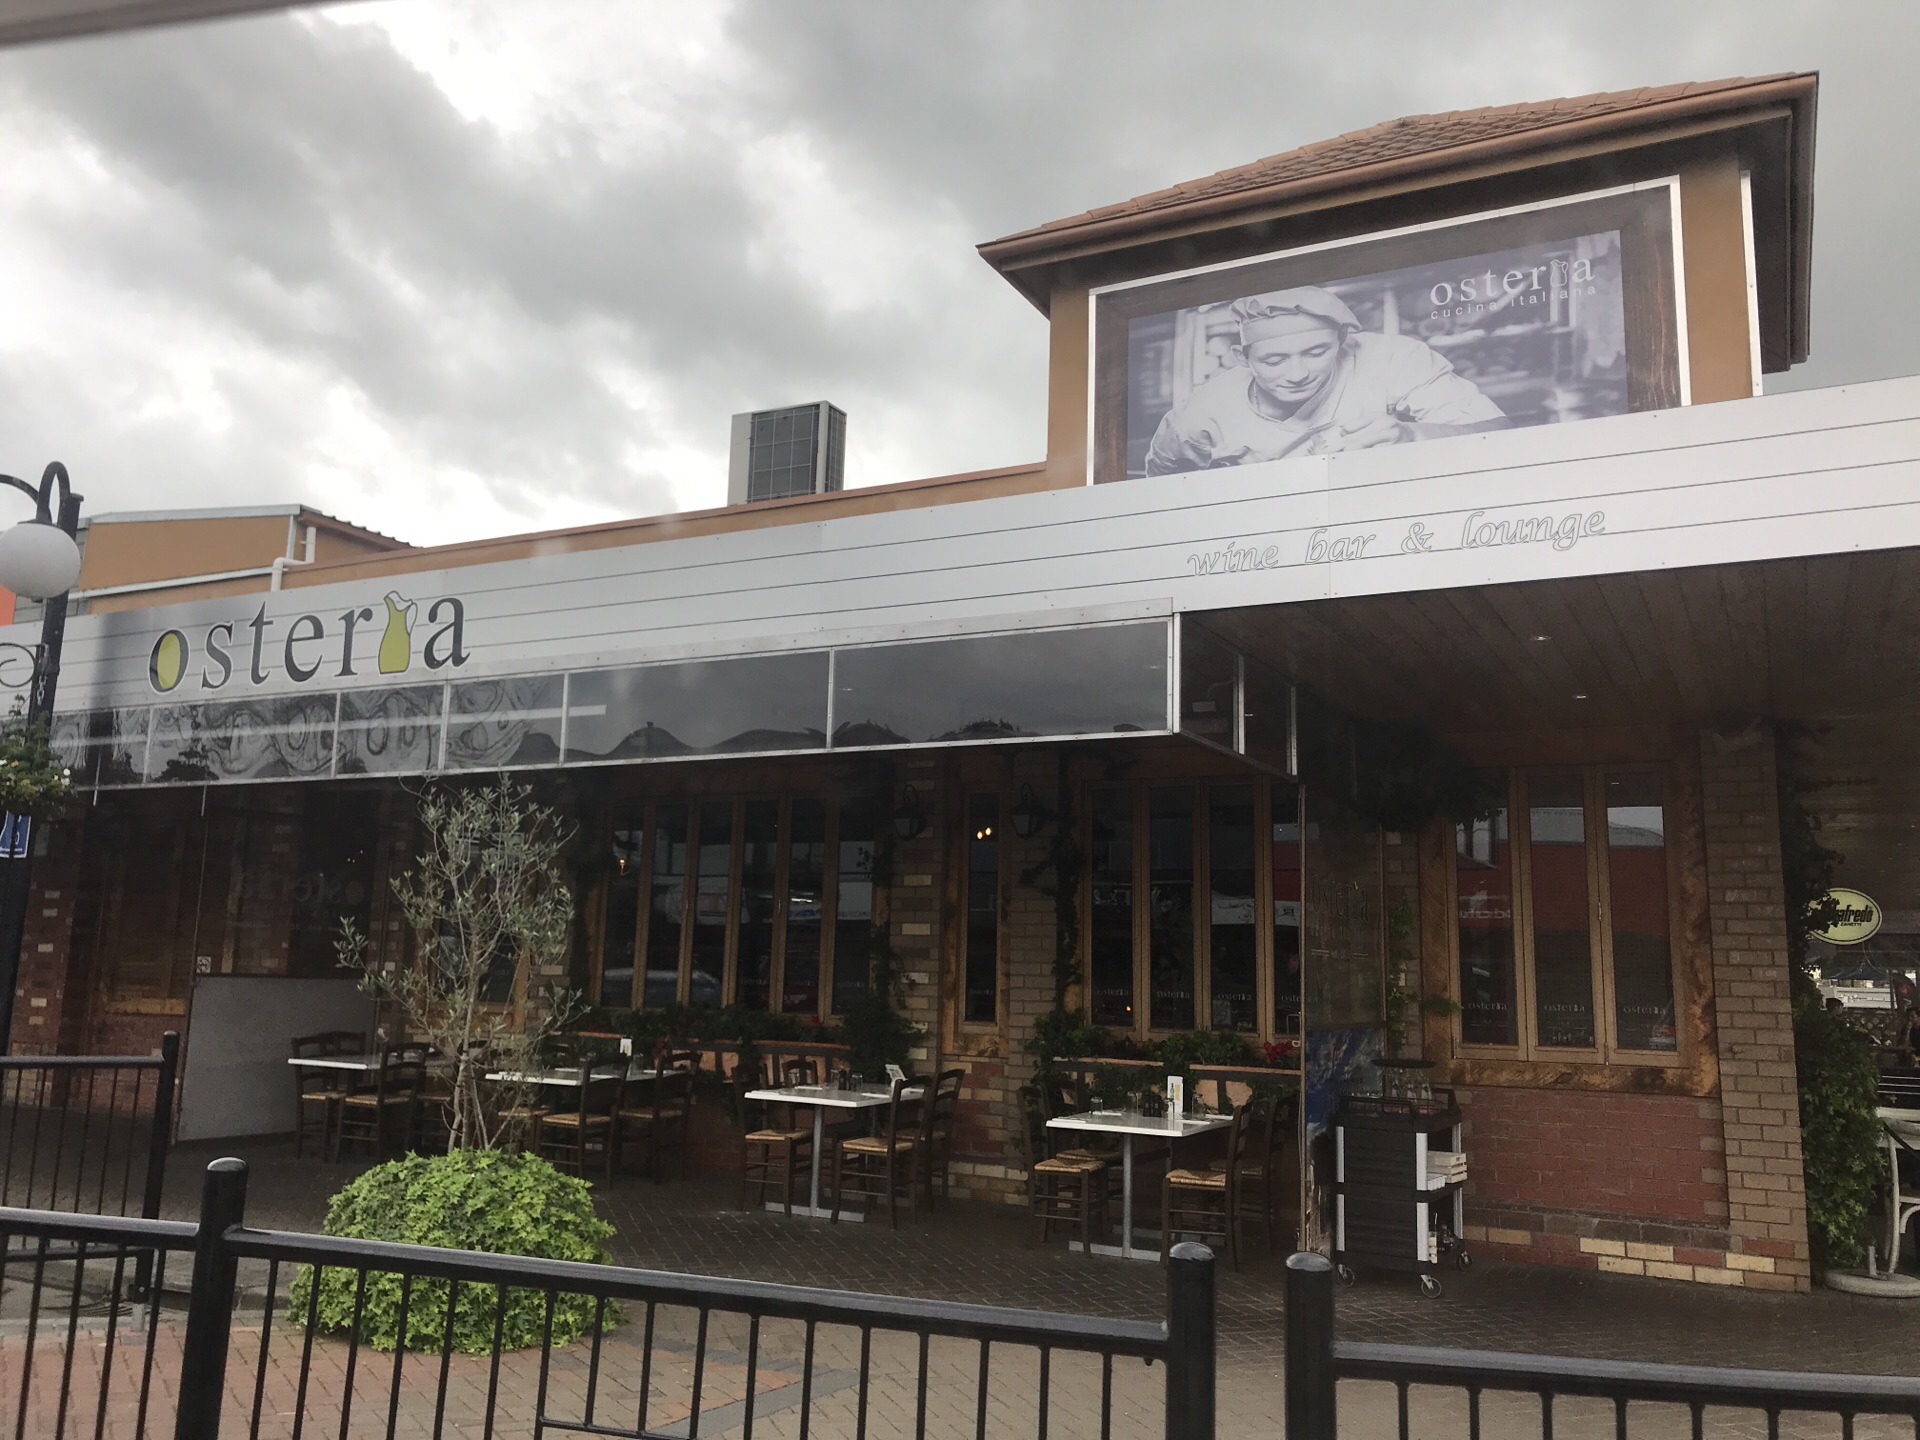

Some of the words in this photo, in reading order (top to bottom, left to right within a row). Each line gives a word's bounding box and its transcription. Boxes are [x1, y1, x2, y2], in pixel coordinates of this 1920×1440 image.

[1431, 301, 1497, 319] cucina
[1511, 286, 1596, 307] italiana
[1187, 541, 1279, 576] wine
[1304, 529, 1376, 565] bar
[1400, 521, 1434, 554] &
[1460, 510, 1606, 551] lounge
